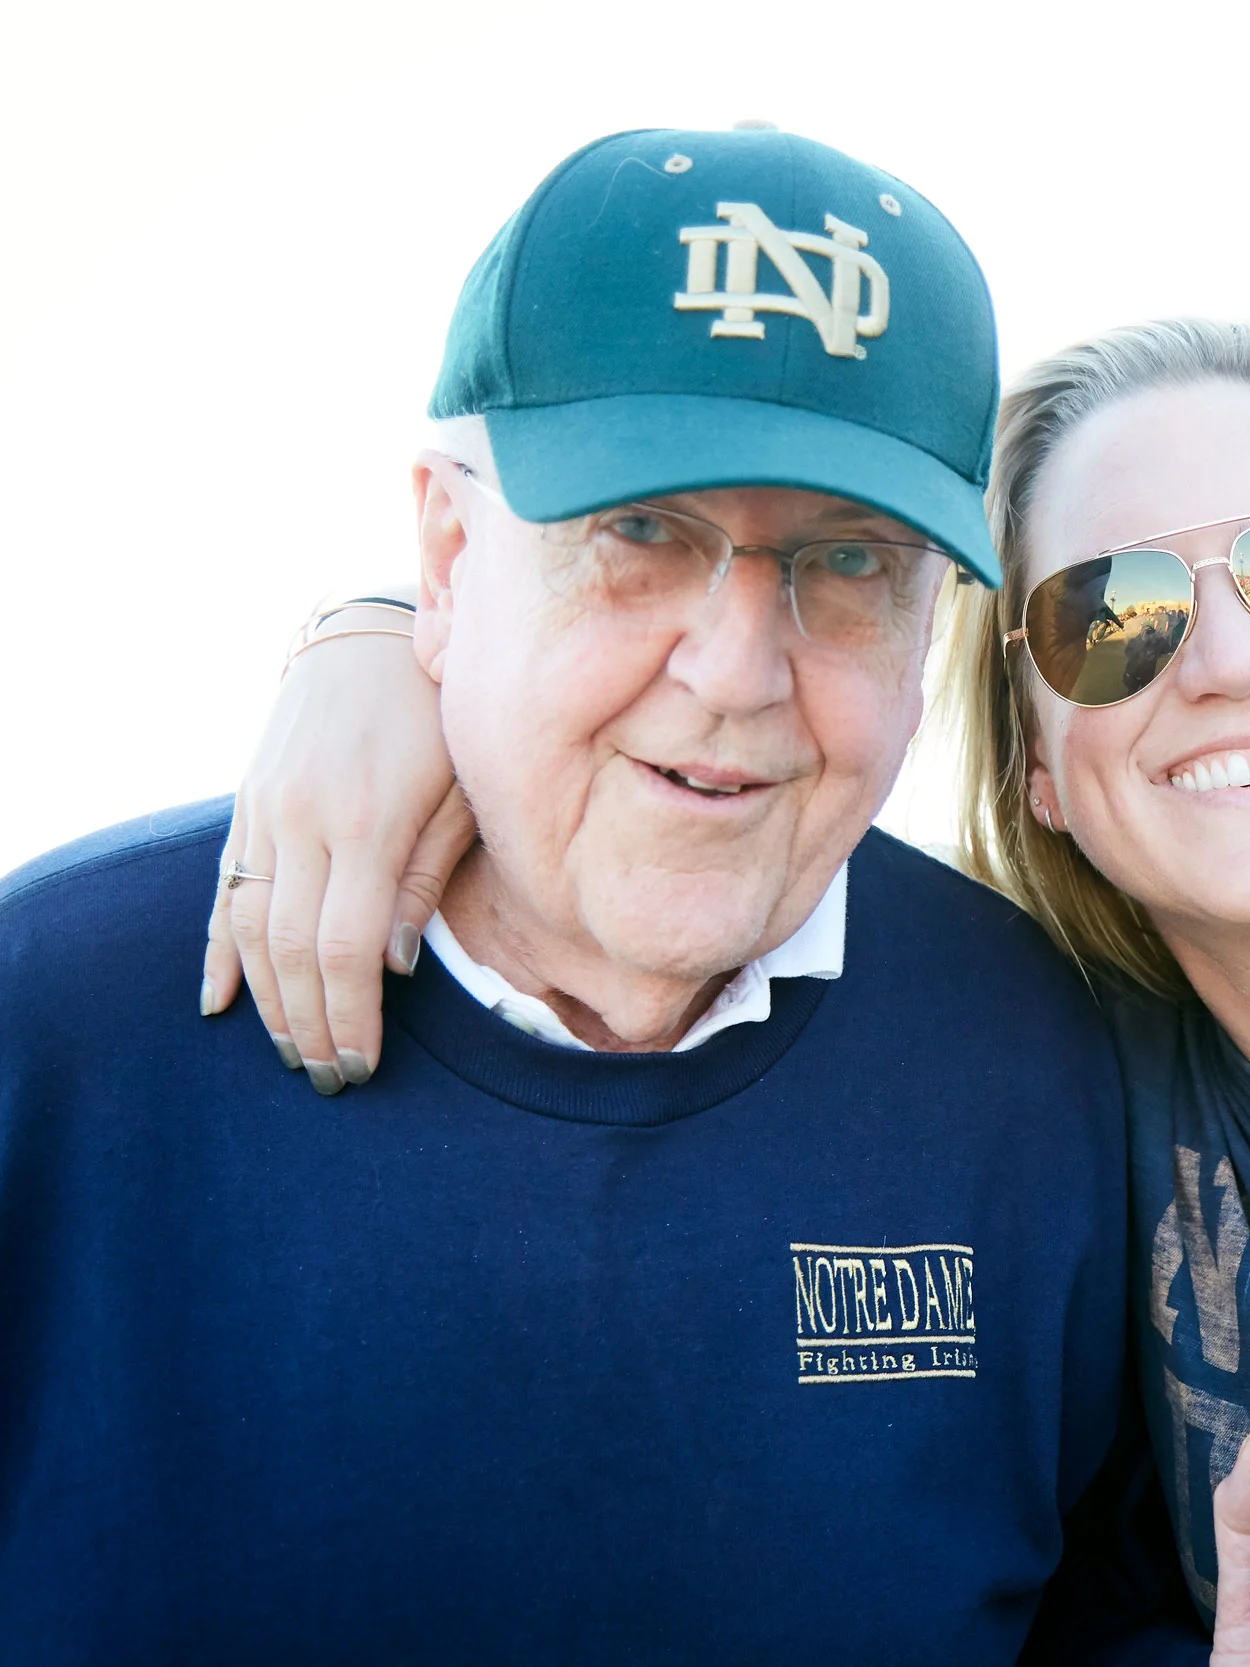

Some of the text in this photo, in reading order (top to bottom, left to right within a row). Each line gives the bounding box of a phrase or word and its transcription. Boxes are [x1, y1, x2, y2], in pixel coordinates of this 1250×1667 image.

[793, 1256, 975, 1334] NOTRE DAME
[797, 1350, 916, 1375] Fighting
